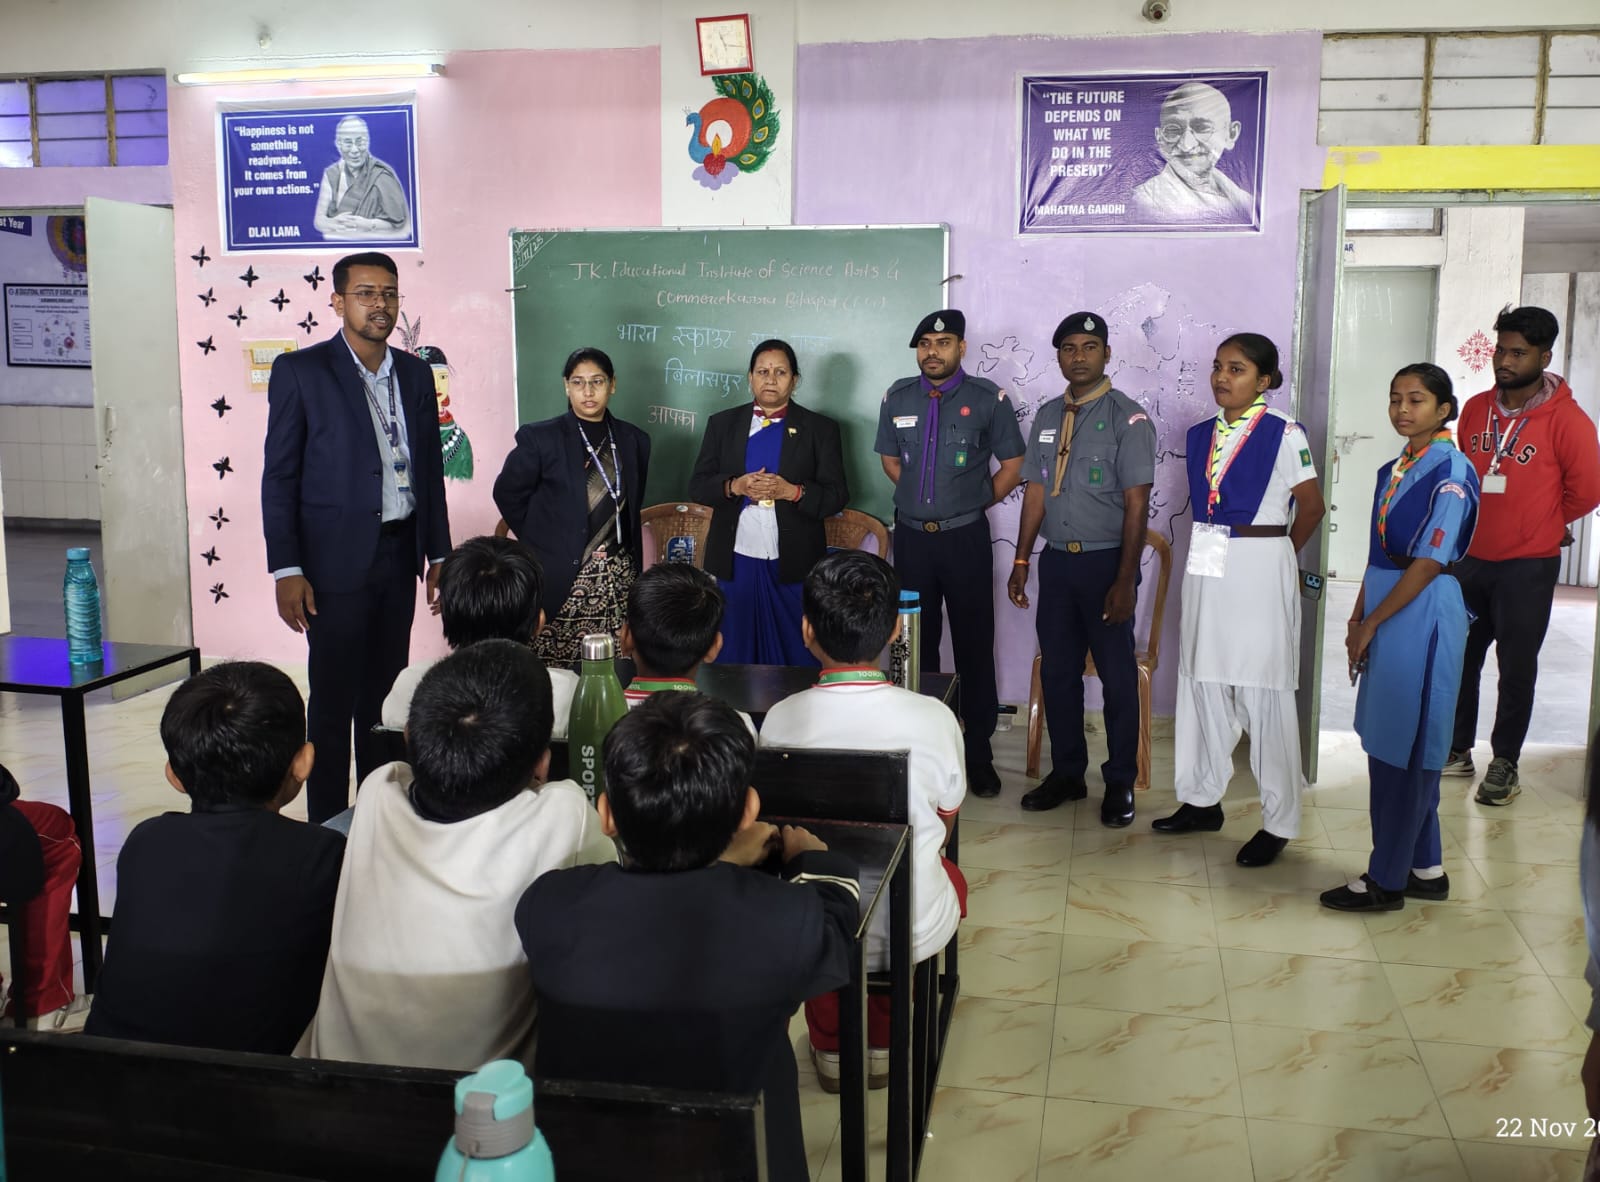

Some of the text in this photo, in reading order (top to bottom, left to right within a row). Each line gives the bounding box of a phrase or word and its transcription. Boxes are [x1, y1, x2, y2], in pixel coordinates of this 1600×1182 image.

[1077, 91, 1125, 104] FUTURE
[1045, 109, 1121, 123] DEPENDS ON
[288, 125, 296, 135] is
[299, 124, 314, 135] not
[1053, 127, 1111, 141] WHAT WE
[251, 141, 298, 152] something
[1051, 146, 1111, 160] DO IN THE
[248, 155, 301, 167] readymade.
[245, 169, 307, 181] It comes from
[234, 187, 253, 198] your
[255, 187, 274, 195] own
[1034, 204, 1125, 215] MAHATMA GANDHI
[248, 225, 301, 238] DLAI LAMA
[758, 258, 776, 280] of
[781, 262, 834, 278] Science
[617, 322, 664, 343] भारत
[664, 357, 745, 398] बिलासपुर
